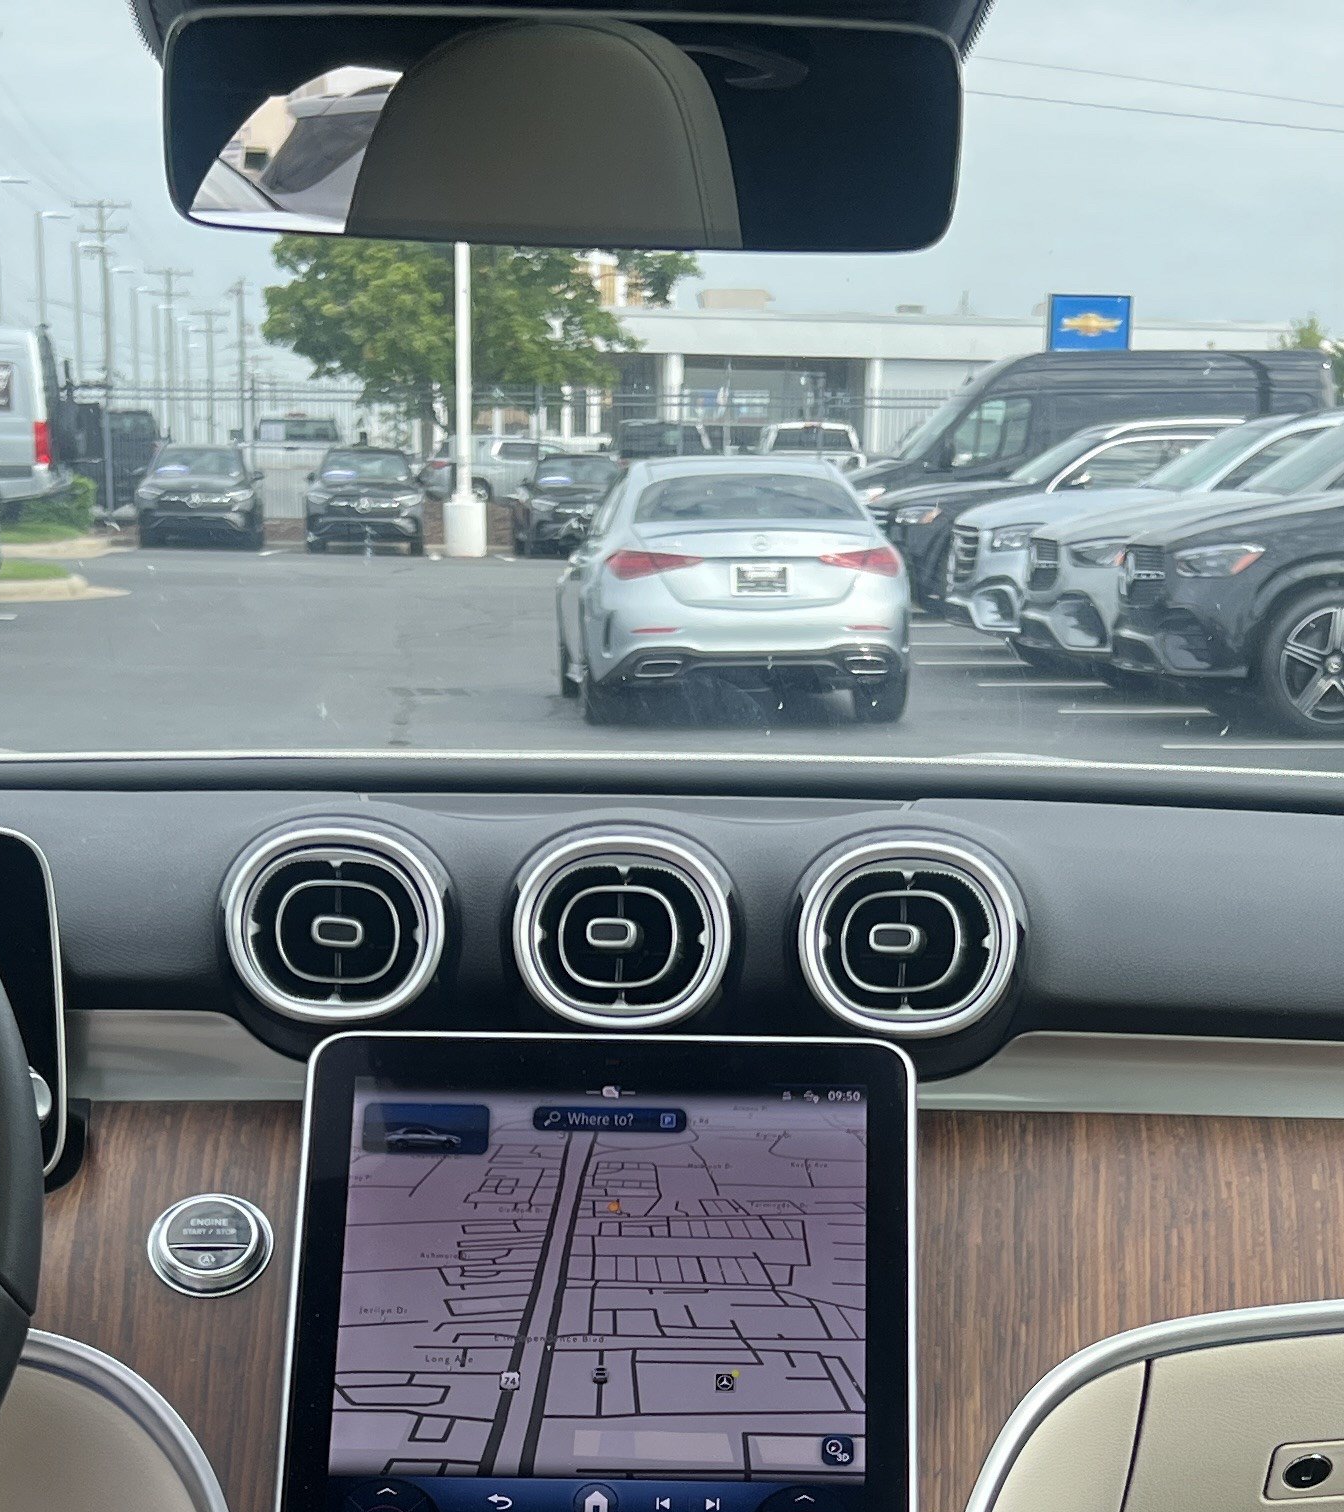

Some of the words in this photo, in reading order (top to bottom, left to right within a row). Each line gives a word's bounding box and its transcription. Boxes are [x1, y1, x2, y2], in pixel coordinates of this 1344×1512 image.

[827, 1090, 861, 1102] 09:50
[567, 1111, 610, 1126] Where
[614, 1112, 634, 1127] to?
[190, 1218, 229, 1227] ENGINE
[182, 1228, 206, 1236] START
[215, 1228, 238, 1236] STOP
[425, 1355, 450, 1365] Long
[455, 1355, 474, 1364] Ae
[504, 1376, 517, 1386] 74
[836, 1452, 850, 1462] 3D
